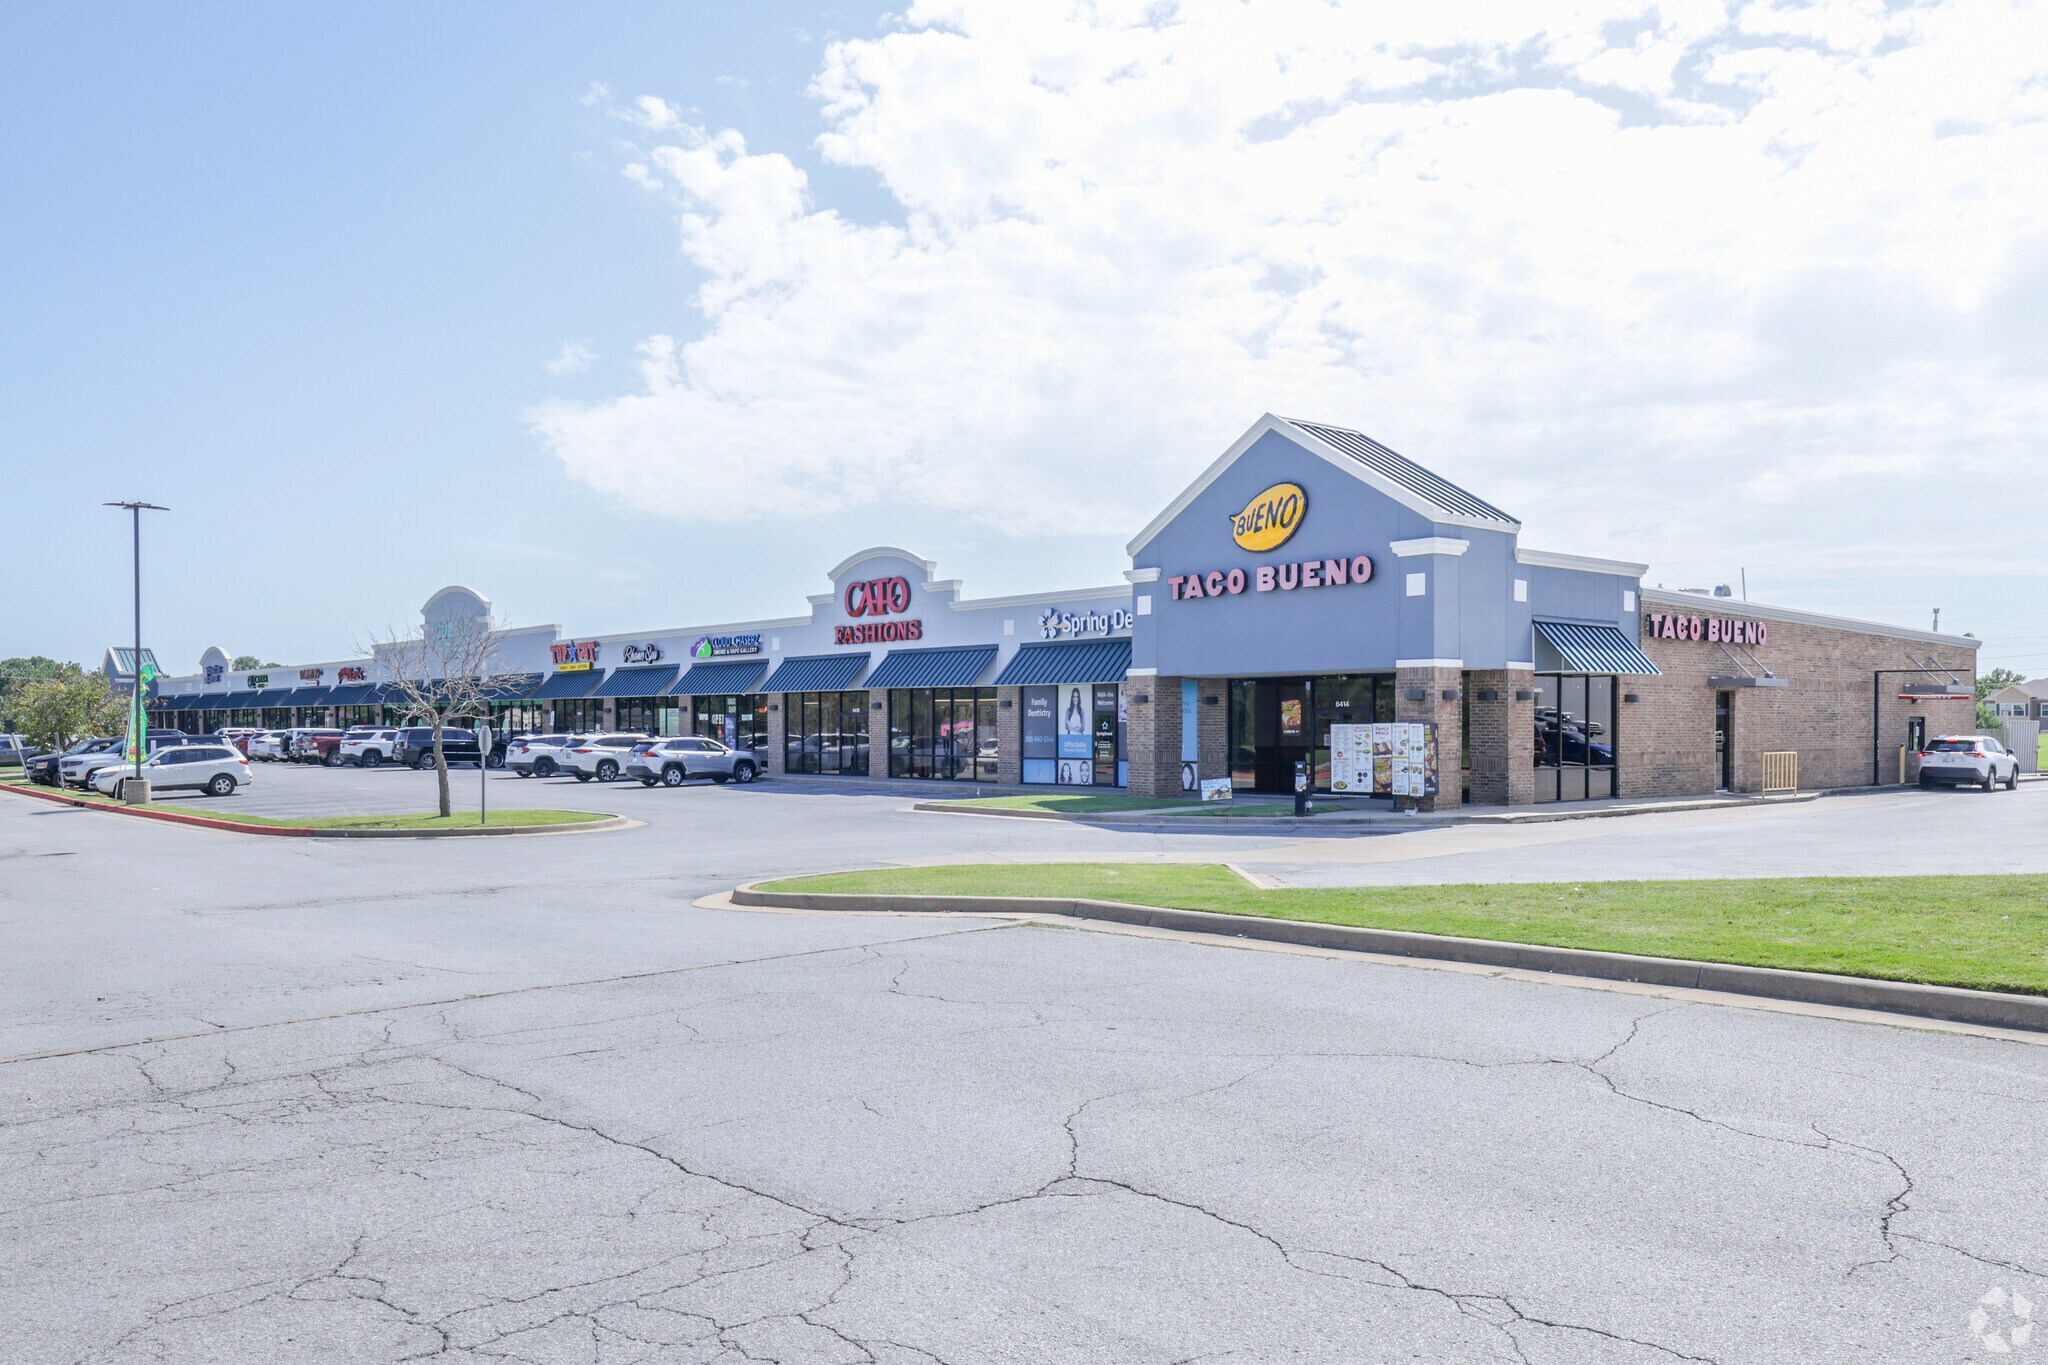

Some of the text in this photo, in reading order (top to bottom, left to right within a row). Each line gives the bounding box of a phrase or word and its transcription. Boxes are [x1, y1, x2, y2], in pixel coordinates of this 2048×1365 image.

[1236, 493, 1298, 536] BUENO
[1168, 555, 1374, 600] TACO BUENO
[844, 577, 910, 617] CATO
[835, 620, 922, 645] FASHIONS
[1062, 610, 1109, 637] Spring
[1650, 613, 1768, 645] TACO BUENO
[550, 641, 596, 664] TOP CUT
[1028, 709, 1052, 718] Dentistry
[1031, 698, 1047, 708] Family
